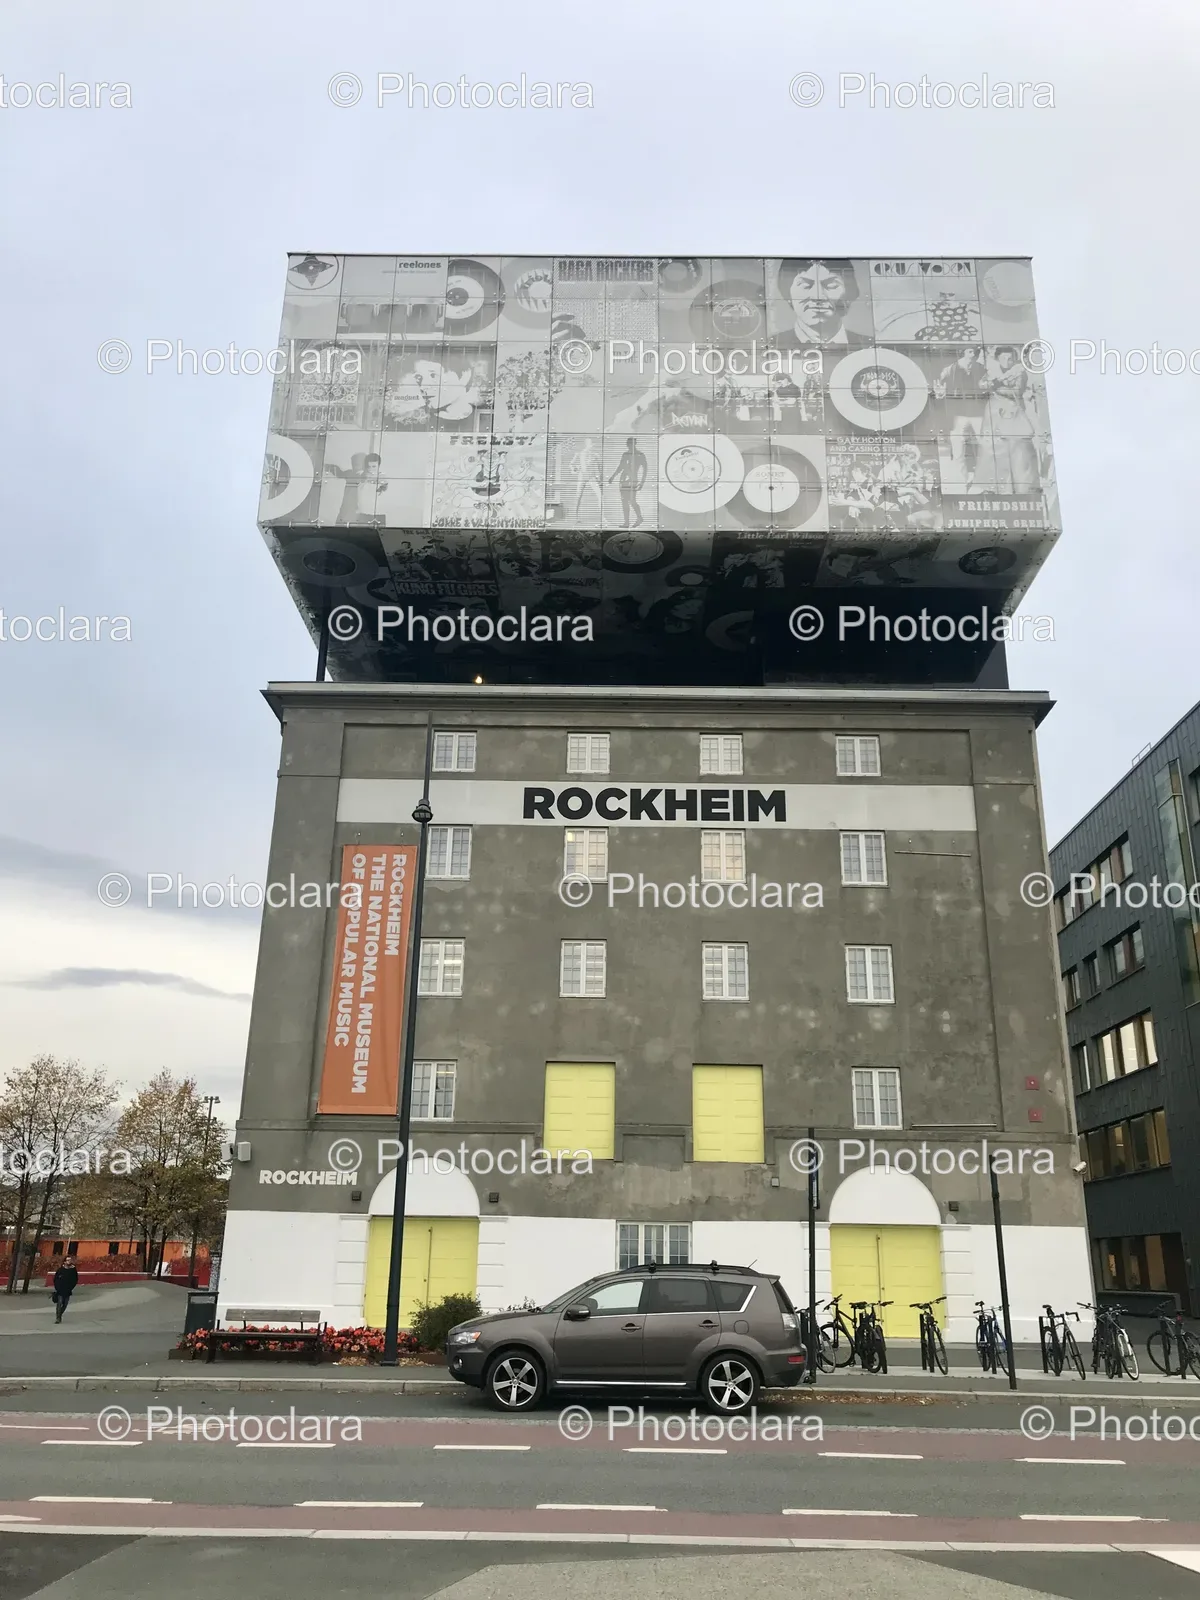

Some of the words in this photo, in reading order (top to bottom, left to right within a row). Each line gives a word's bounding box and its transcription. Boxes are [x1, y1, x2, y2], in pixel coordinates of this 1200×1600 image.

[829, 445, 847, 453] AND
[848, 445, 881, 453] CASINO
[836, 436, 860, 445] GARY
[957, 500, 1044, 511] FRIENDSHIP
[736, 532, 765, 540] Little
[791, 532, 824, 540] Wilson
[395, 582, 436, 595] KUNG
[437, 582, 455, 596] FU
[456, 583, 500, 597] GIRLS
[523, 787, 787, 822] ROCKHEIM
[351, 853, 367, 880] OF
[370, 853, 387, 891] THE
[384, 854, 407, 956] ROCKHEIM
[341, 884, 364, 977] POPULAR
[359, 896, 383, 999] NATIONAL
[334, 982, 355, 1047] MUSIC
[351, 1003, 374, 1093] MUSEUM
[259, 1169, 358, 1186] ROCKHEIM
